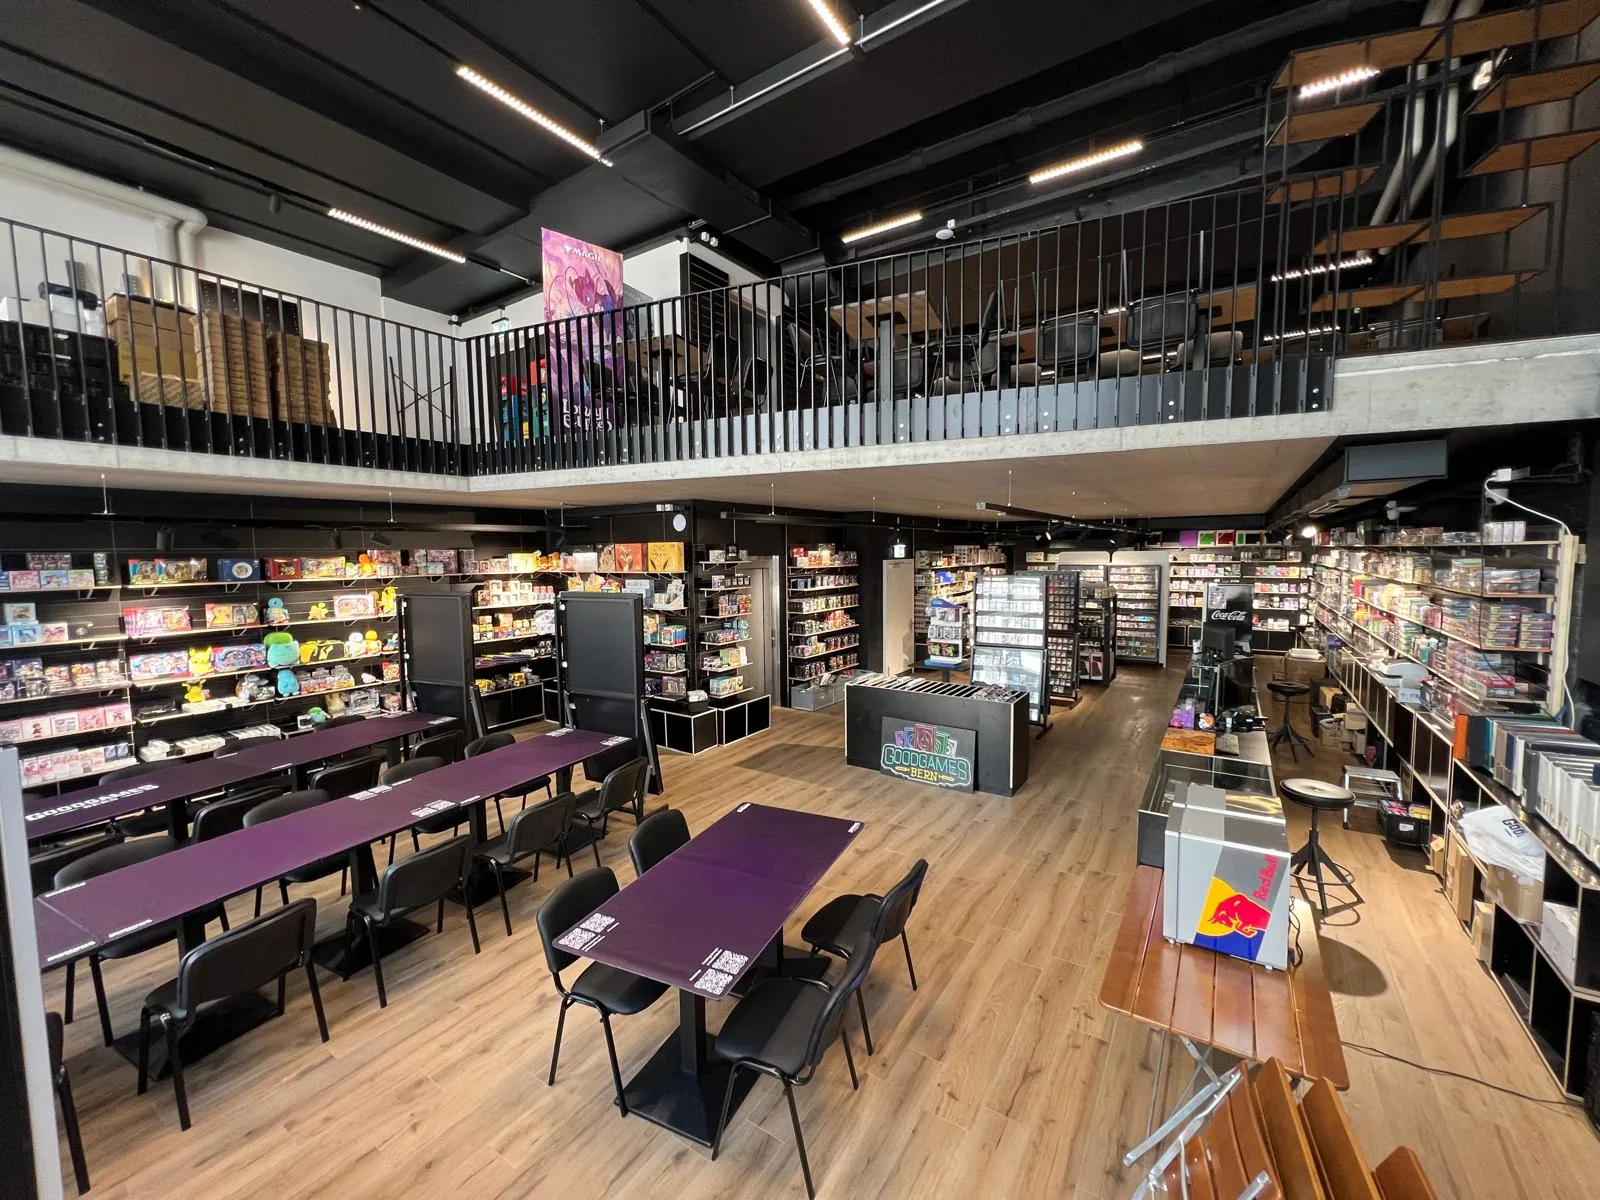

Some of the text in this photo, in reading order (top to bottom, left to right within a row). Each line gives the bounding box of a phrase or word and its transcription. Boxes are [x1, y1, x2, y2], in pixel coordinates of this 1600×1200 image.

[884, 747, 968, 781] GOODGAMES
[911, 767, 939, 781] BERN
[1252, 854, 1279, 901] Red Bull
